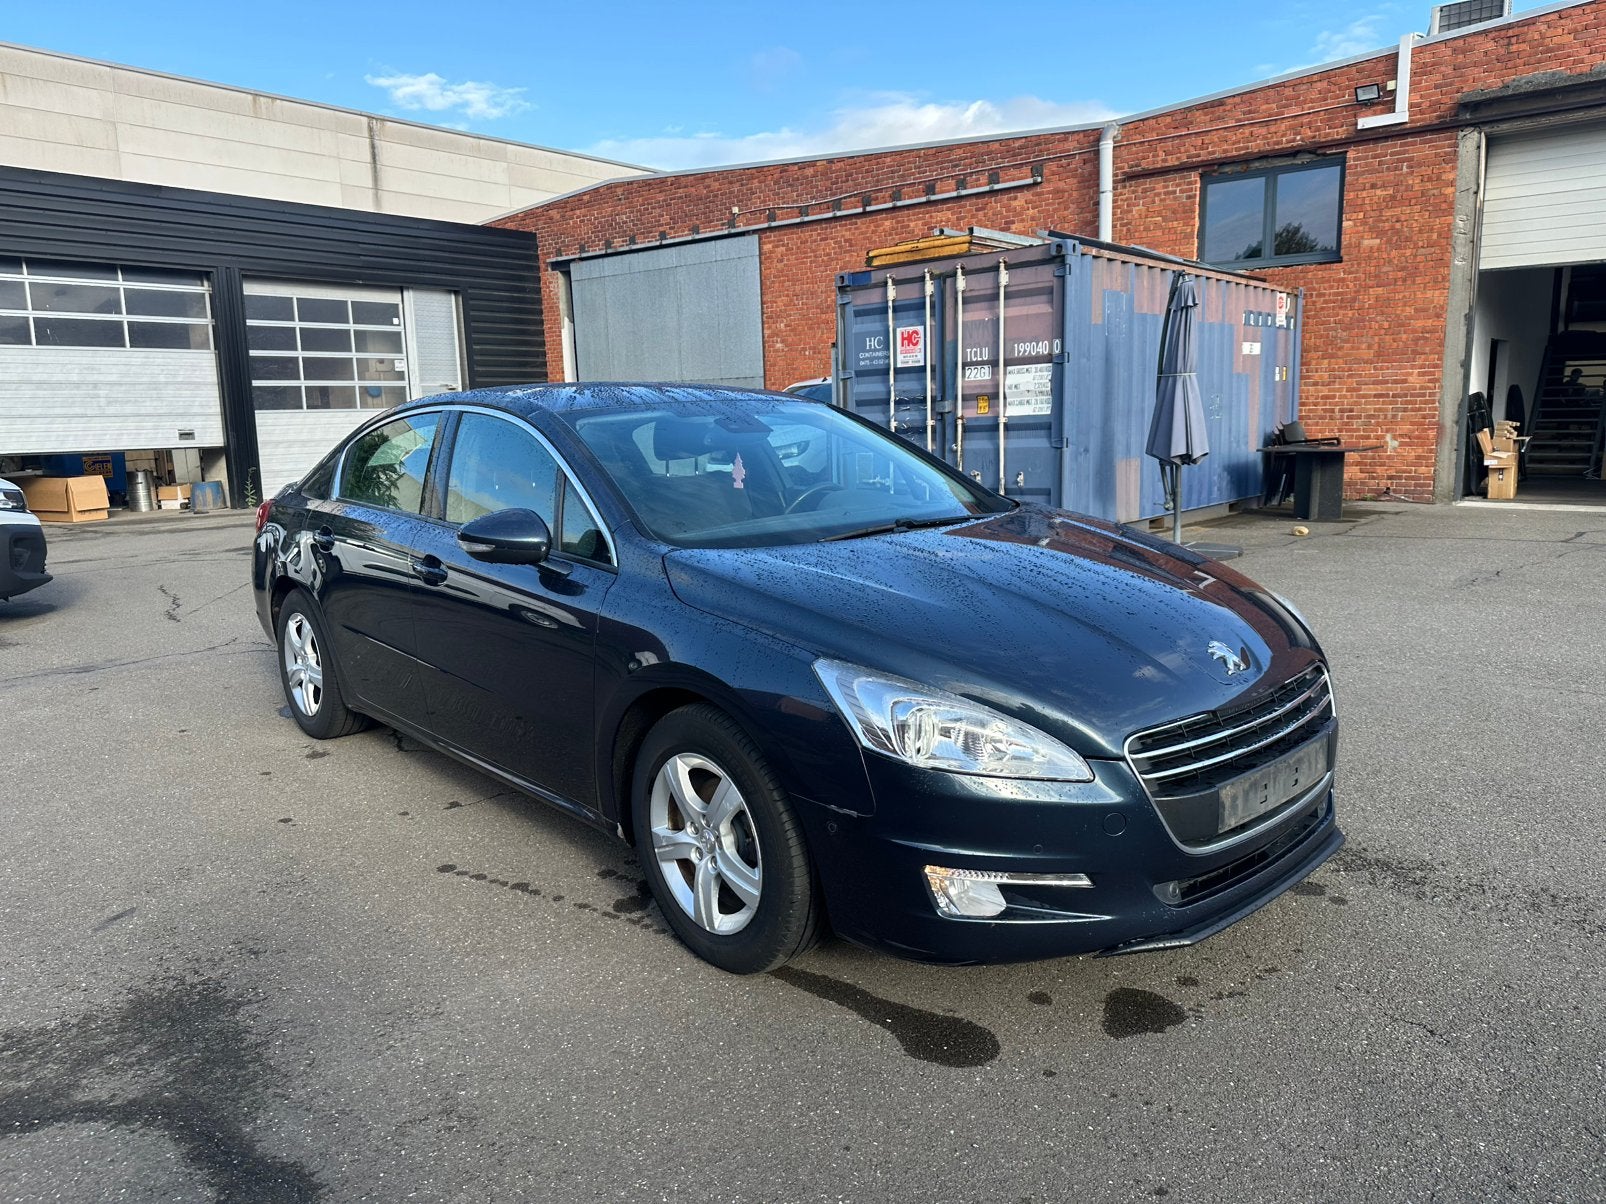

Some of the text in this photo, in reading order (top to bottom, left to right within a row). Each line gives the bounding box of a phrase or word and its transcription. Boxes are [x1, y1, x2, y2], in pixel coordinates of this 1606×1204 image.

[866, 336, 883, 349] HC
[901, 329, 920, 347] HC
[966, 339, 1061, 361] TCLU 199040 0
[966, 366, 991, 380] 22G1
